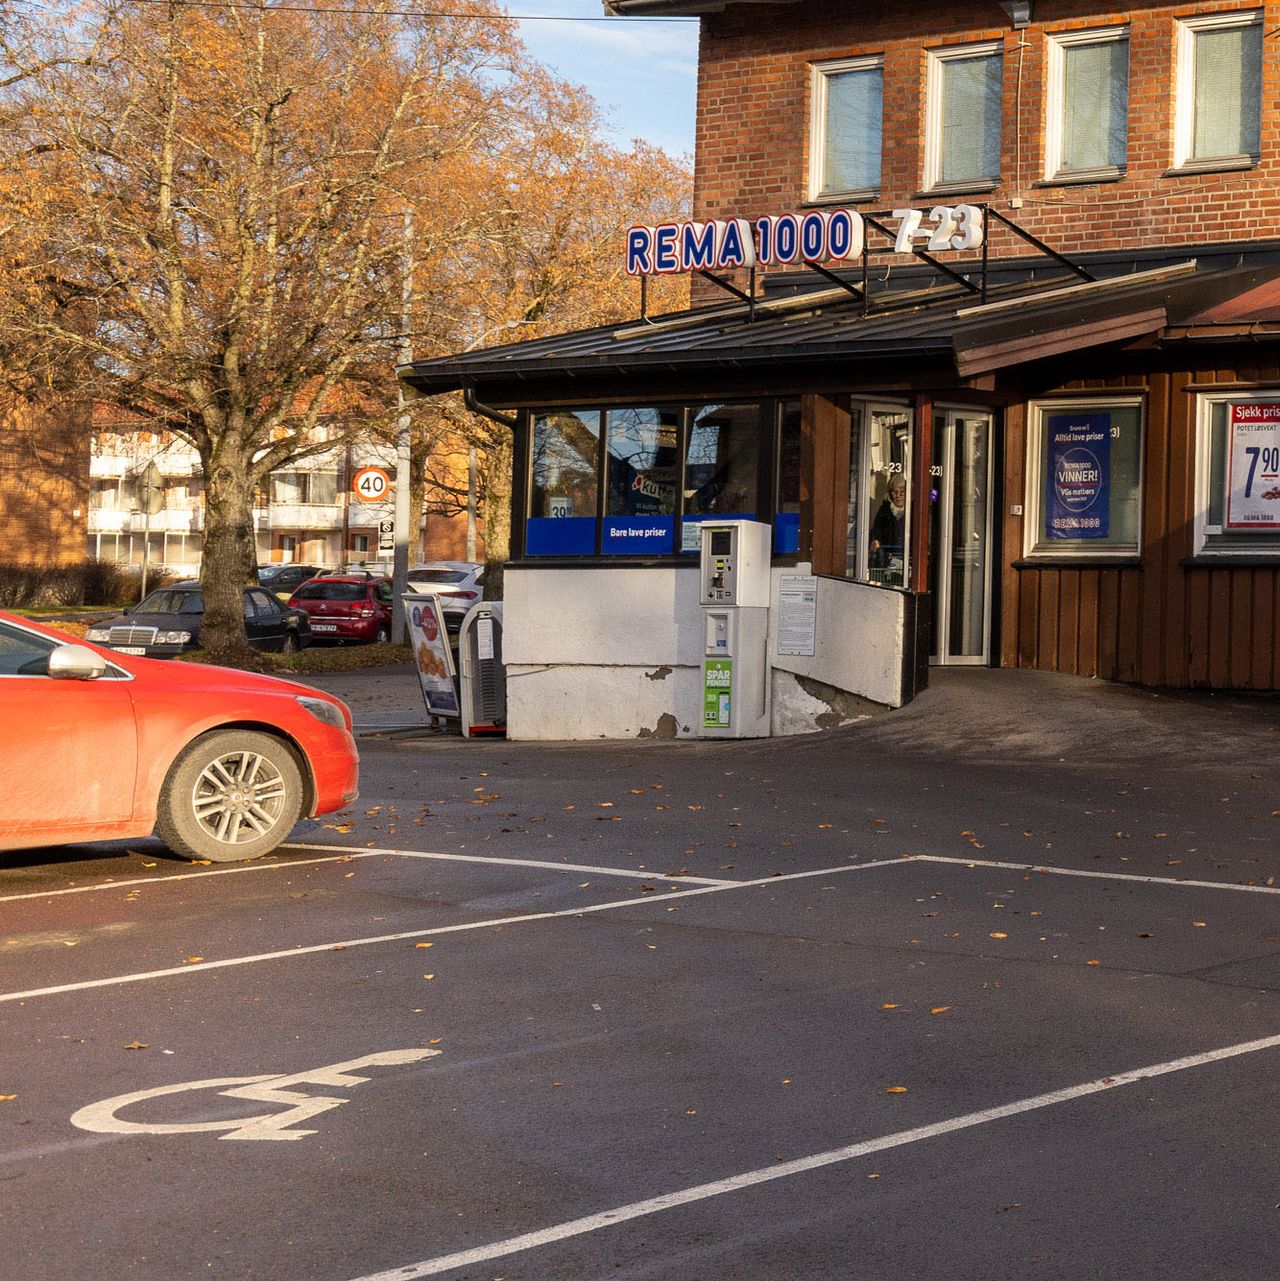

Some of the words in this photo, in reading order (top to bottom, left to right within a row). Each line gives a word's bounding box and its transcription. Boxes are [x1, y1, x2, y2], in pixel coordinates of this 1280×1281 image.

[893, 203, 983, 253] 7-23
[626, 218, 746, 276] REMA
[756, 208, 852, 266] 1000
[1236, 406, 1262, 420] Sjekk
[1055, 433, 1072, 442] Alltid
[1072, 433, 1085, 441] lave
[1086, 432, 1105, 442] priser
[1059, 470, 1098, 483] VINNER!
[1244, 446, 1261, 498] 7
[1261, 447, 1280, 473] 90
[360, 476, 384, 493] 40
[1060, 488, 1072, 496] VGs
[1053, 518, 1079, 529] REMA
[1080, 517, 1101, 528] 1000
[610, 527, 627, 537] Bare
[628, 528, 643, 537] lave
[644, 527, 666, 538] priser
[706, 670, 731, 680] SPAR
